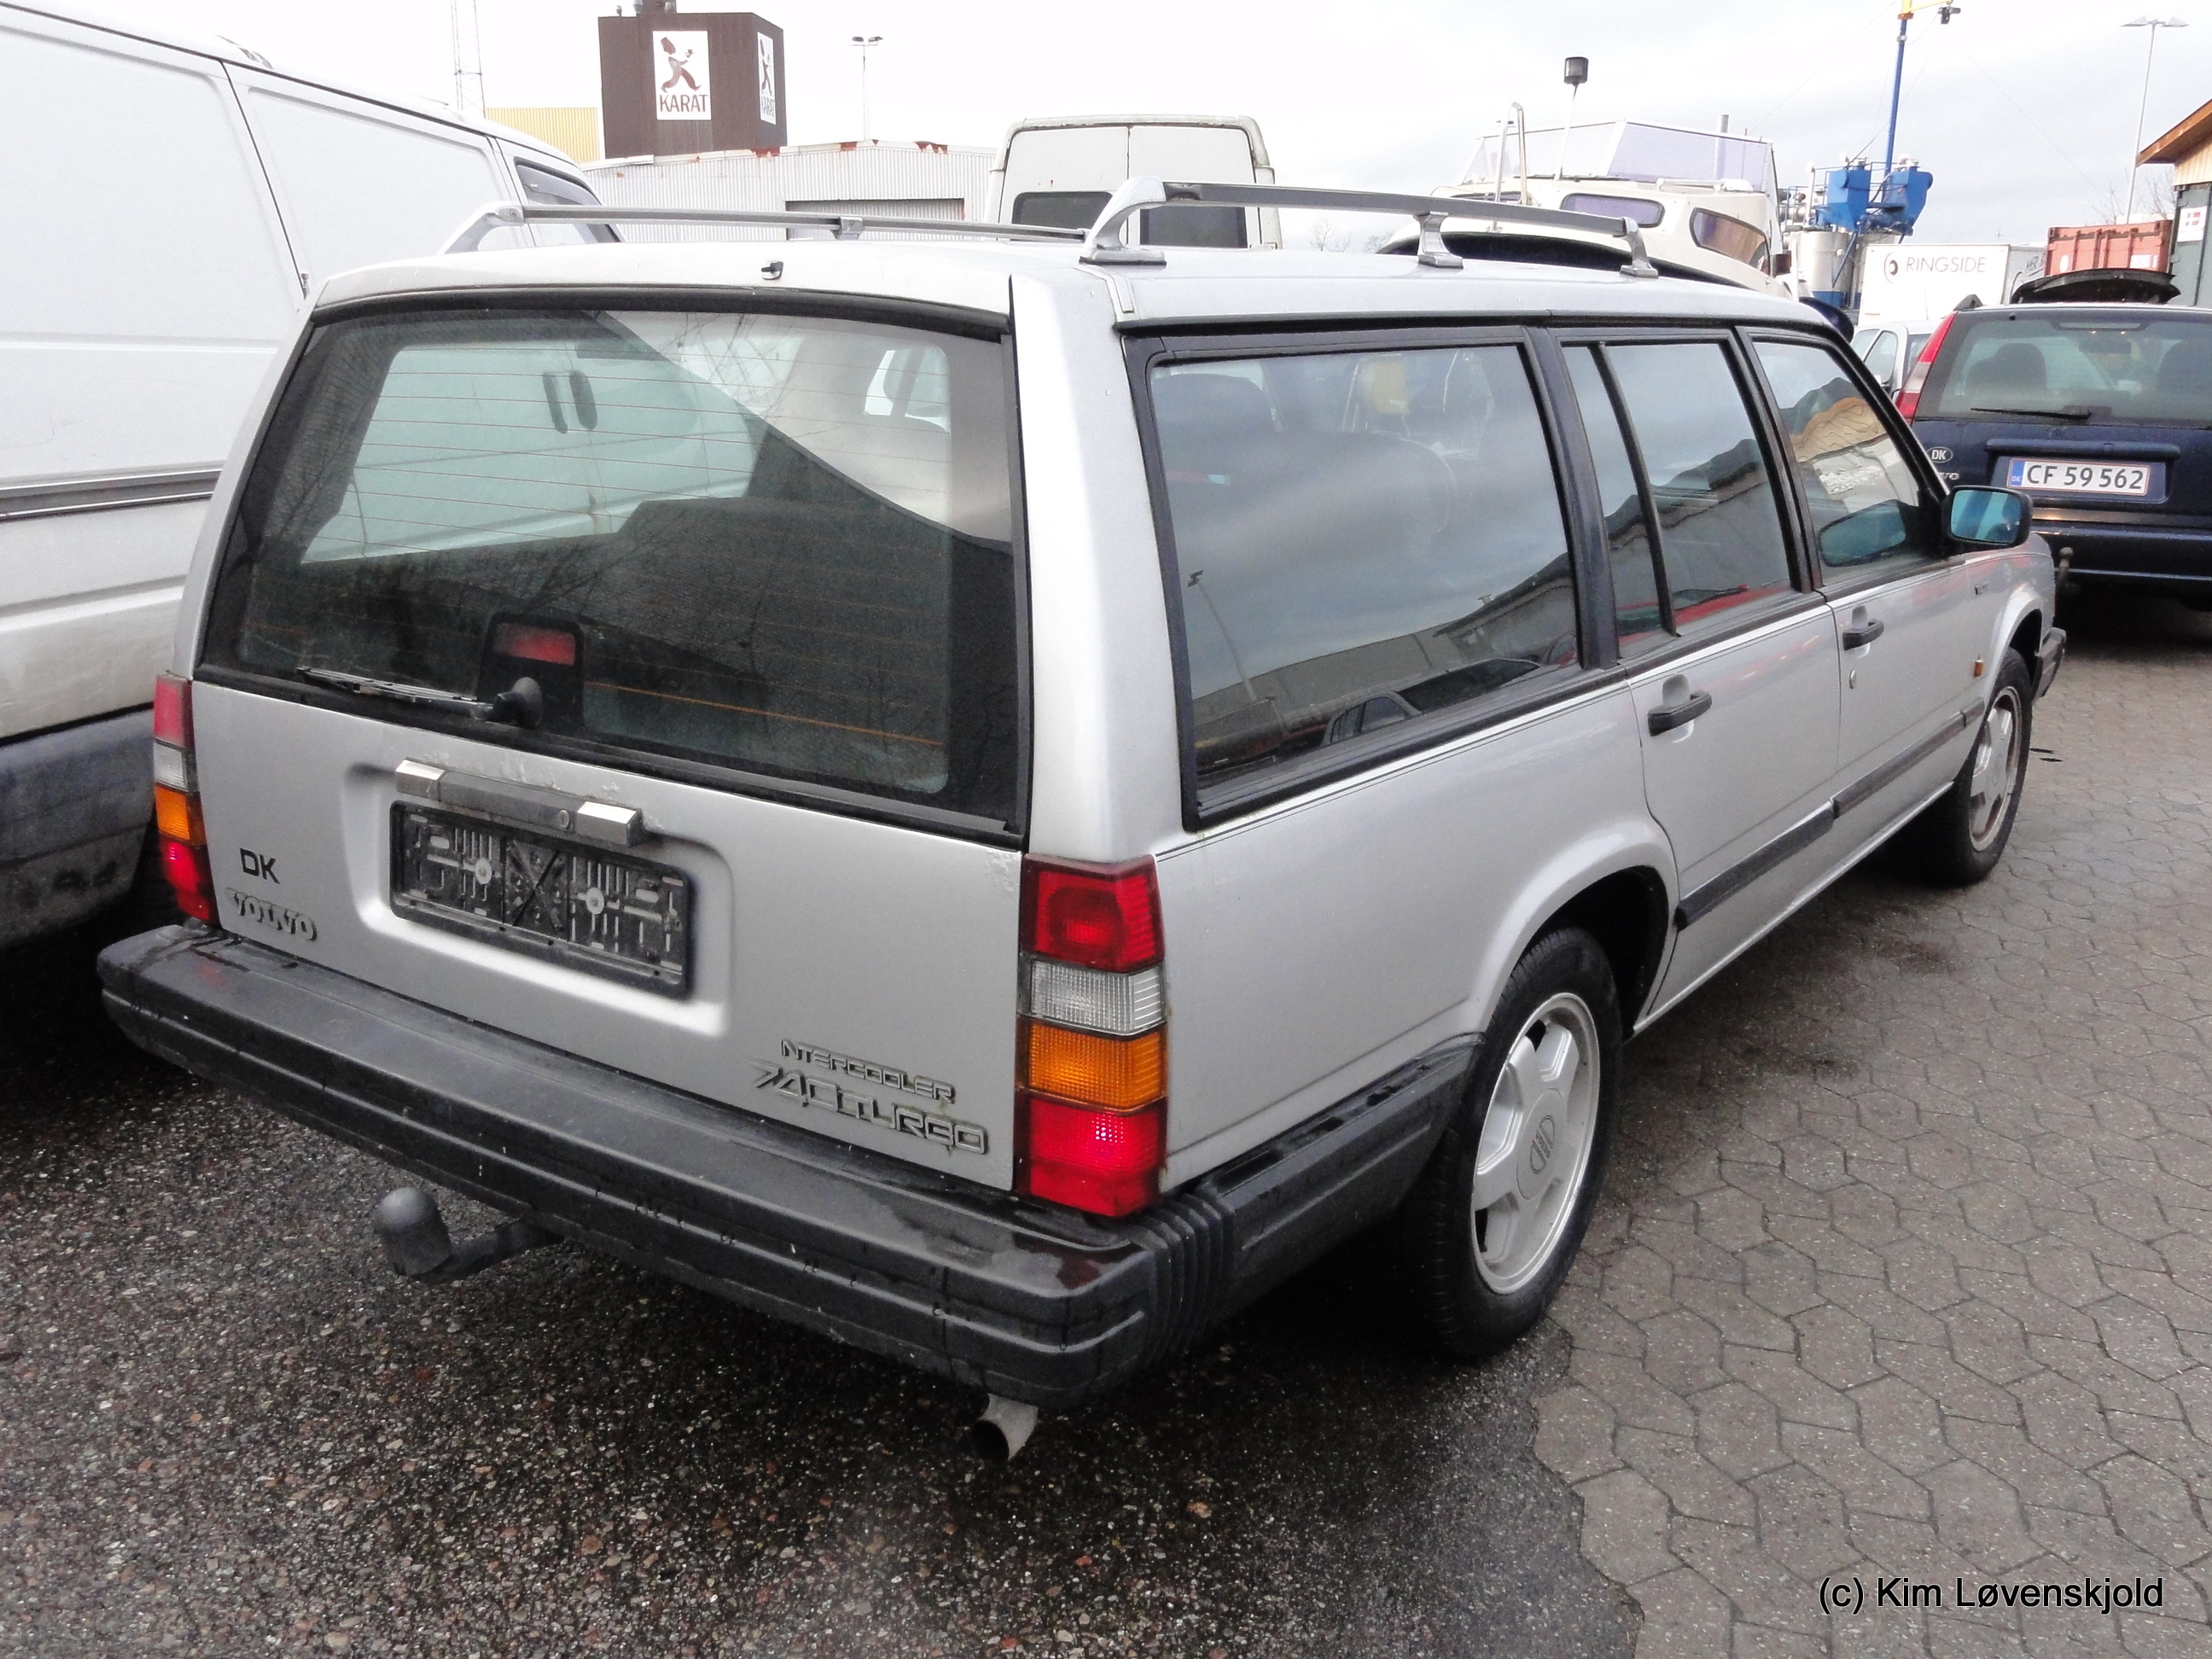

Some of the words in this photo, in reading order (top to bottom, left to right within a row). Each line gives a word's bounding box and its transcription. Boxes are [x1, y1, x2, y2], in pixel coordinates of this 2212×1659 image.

[660, 94, 708, 113] KARAT
[1906, 257, 1986, 272] RINGSIDE
[1931, 449, 1947, 460] DK
[2027, 464, 2058, 484] CF
[2064, 467, 2093, 487] 59
[2098, 468, 2144, 490] 562
[240, 847, 280, 884] DK
[227, 887, 317, 942] VOLVO
[779, 1039, 955, 1104] INTERCOOLER
[750, 1057, 841, 1112] 740
[837, 1089, 988, 1155] TURBO
